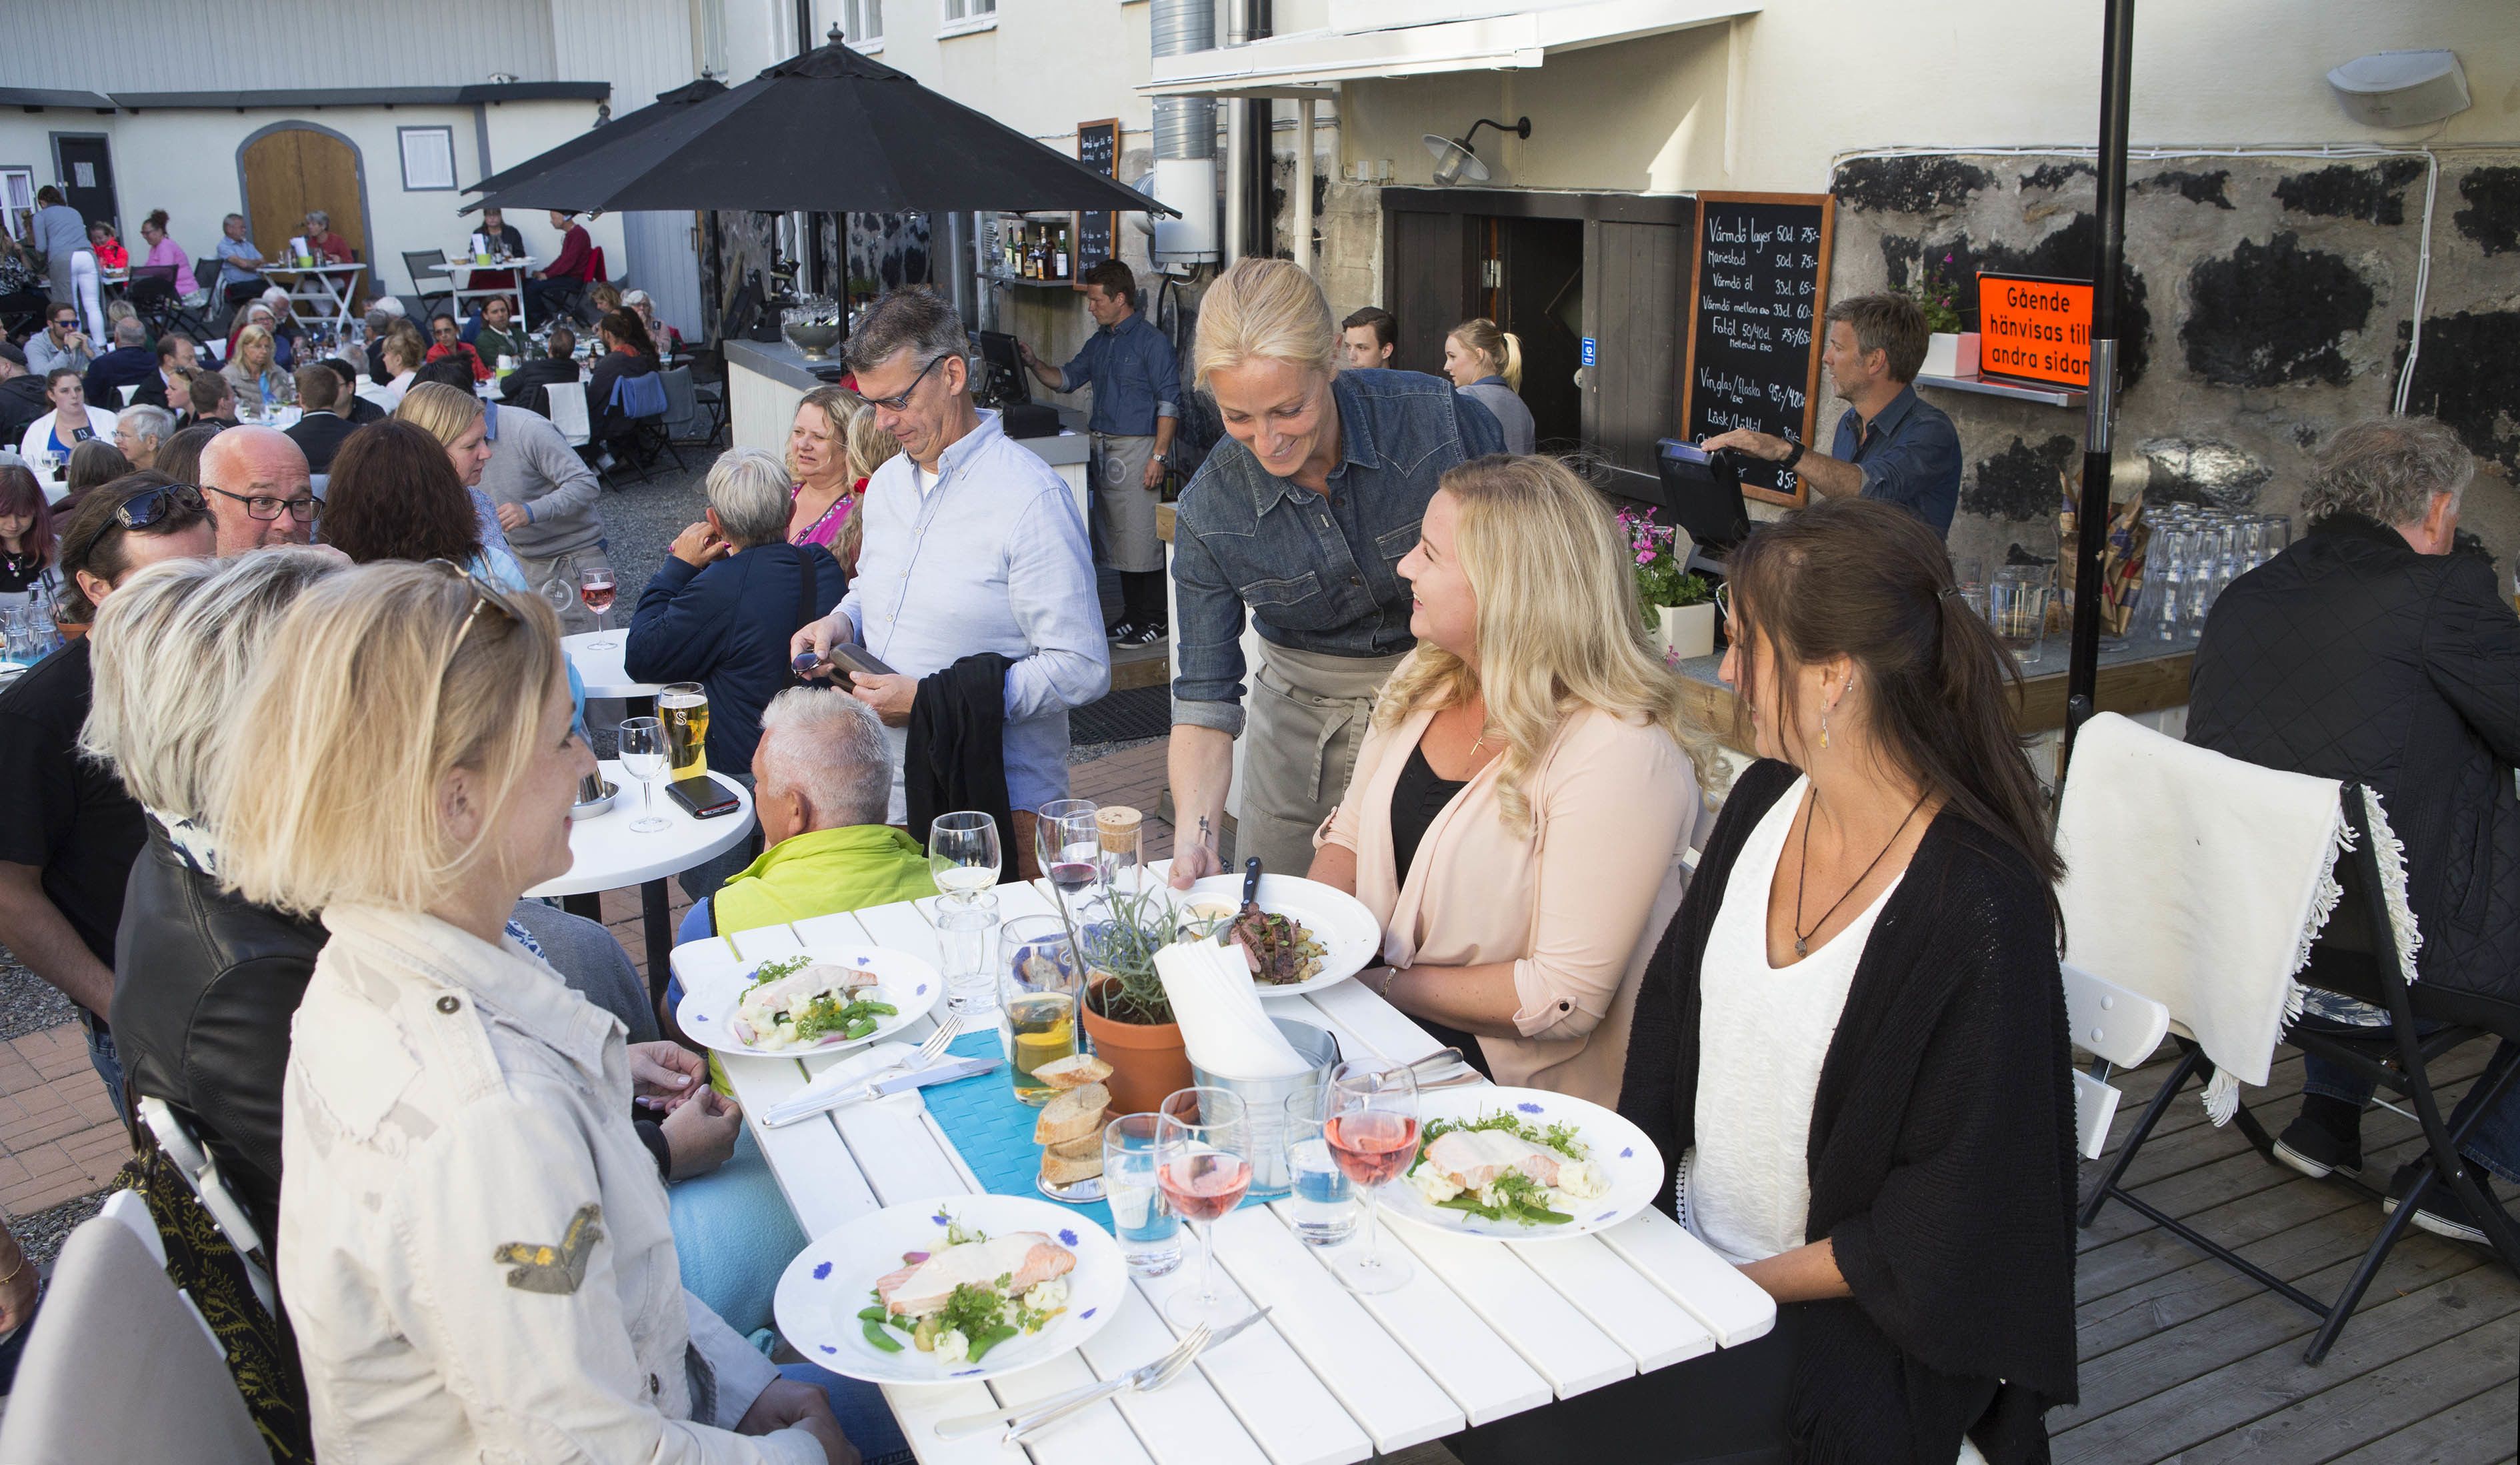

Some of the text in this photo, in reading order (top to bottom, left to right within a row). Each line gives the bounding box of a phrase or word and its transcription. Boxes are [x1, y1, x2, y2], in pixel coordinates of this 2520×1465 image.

[1750, 217, 1773, 253] lager
[1708, 248, 1747, 268] Mariestad
[1713, 272, 1741, 290] Värmdö
[1744, 274, 1753, 291] öl
[1703, 295, 1731, 311] Värmdö
[1733, 301, 1758, 314] mellan
[2007, 286, 2071, 313] Gående
[1713, 316, 1737, 336] Fatöl
[1990, 313, 2091, 347] hänvisas till
[1759, 342, 1773, 352] EKO
[1992, 345, 2038, 369] andra
[77, 429, 88, 440] 13
[1776, 469, 1797, 489] 35:-
